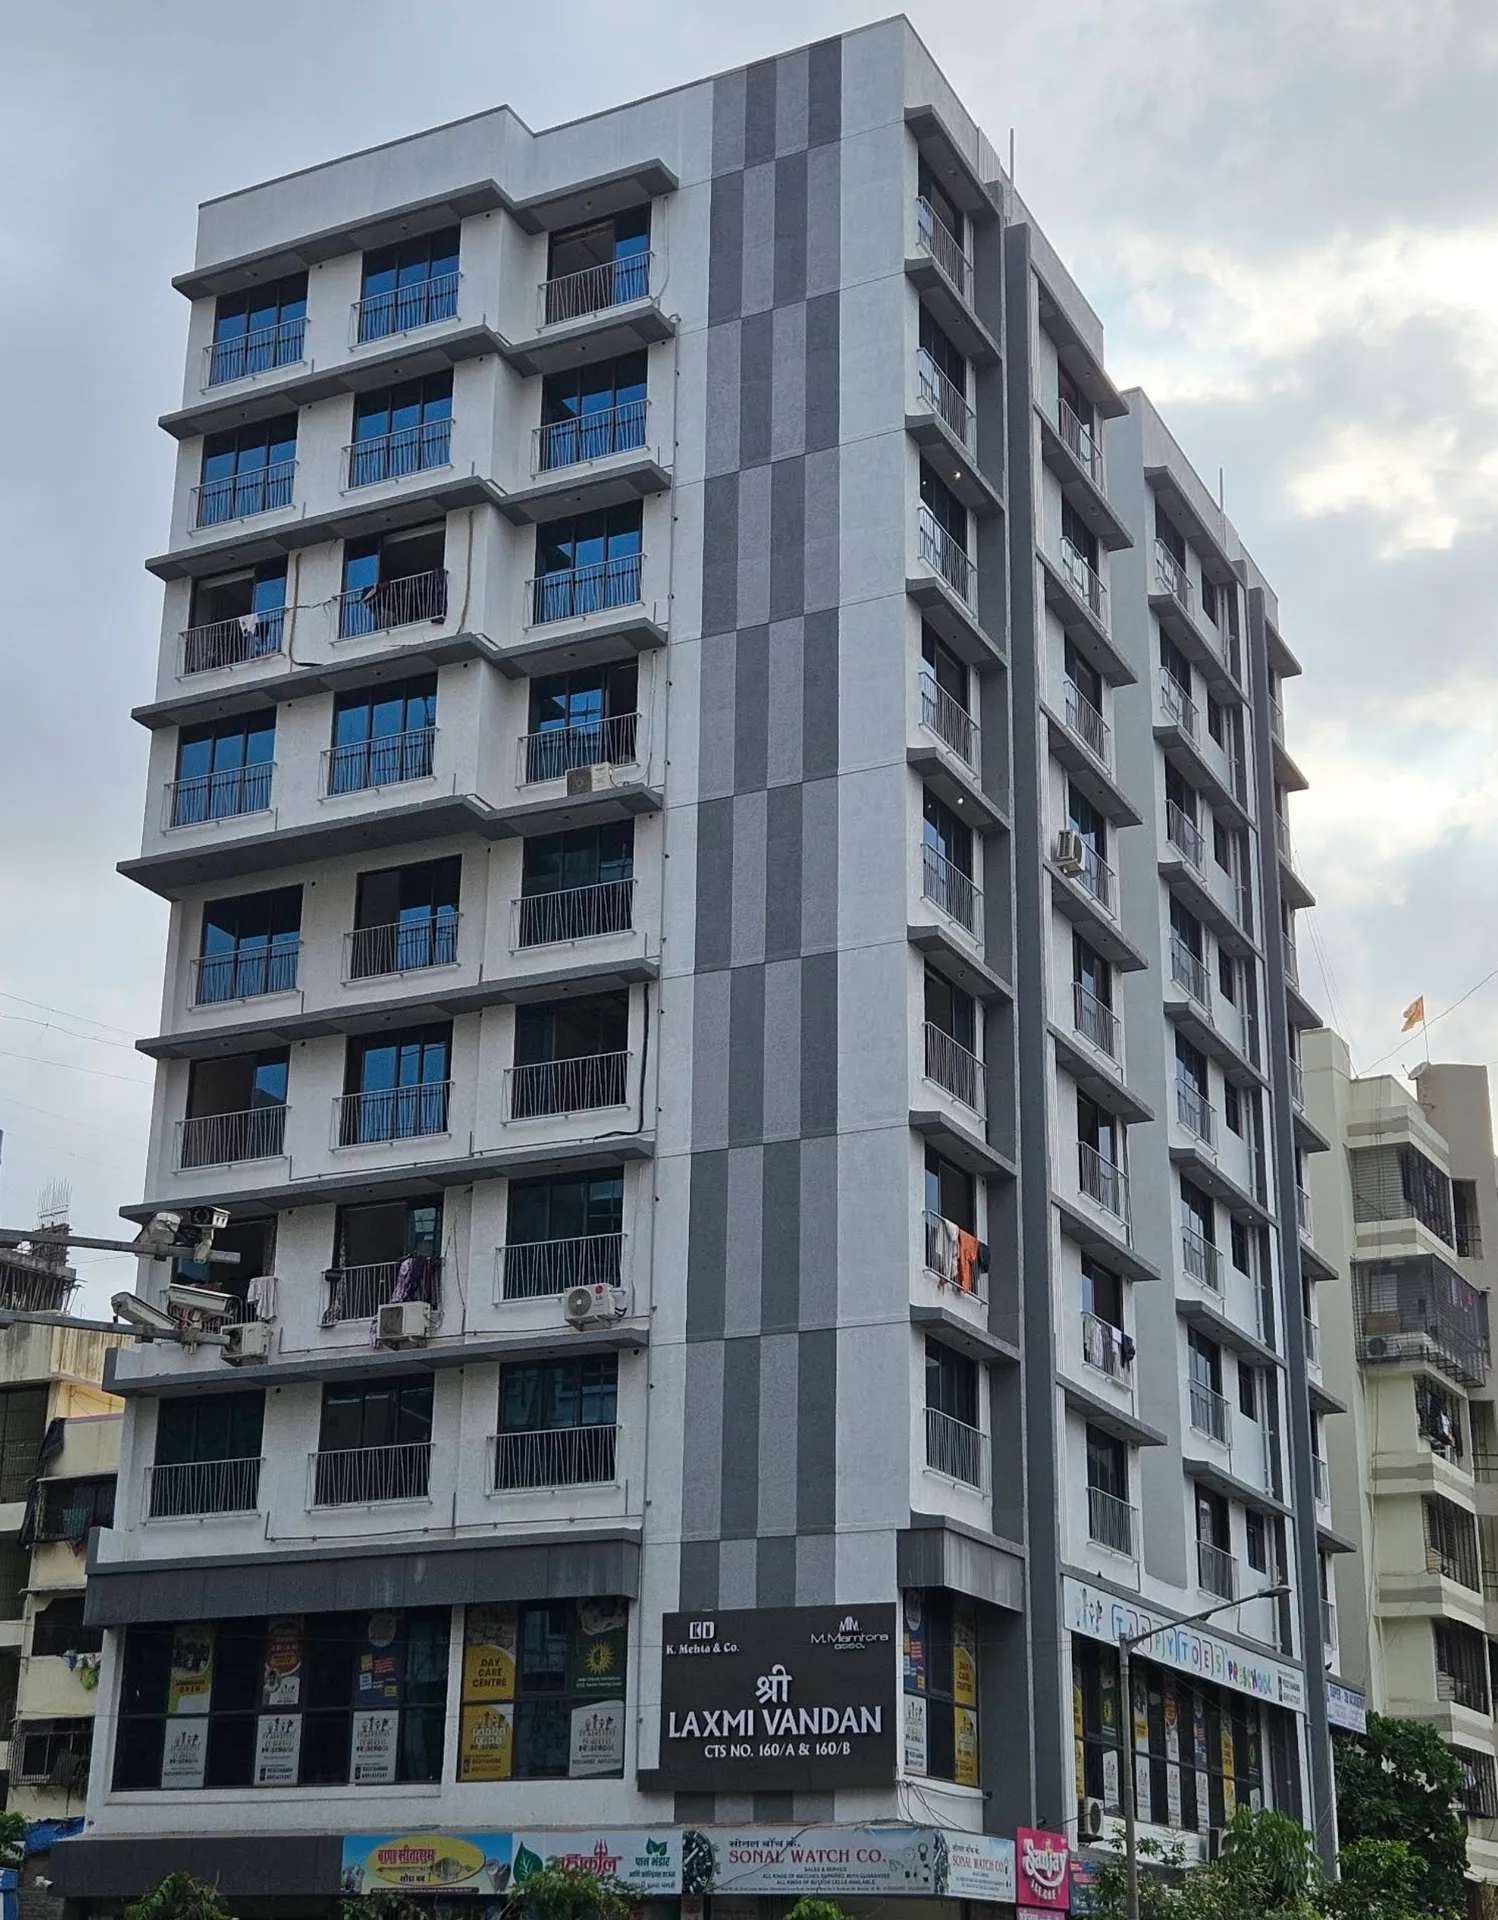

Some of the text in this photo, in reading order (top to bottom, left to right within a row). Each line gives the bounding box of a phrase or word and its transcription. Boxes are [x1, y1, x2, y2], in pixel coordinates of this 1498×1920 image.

[666, 1642, 740, 1655] K. Mehta & Co.
[480, 1658, 501, 1667] DAY
[1180, 1641, 1222, 1674] TOES
[478, 1667, 502, 1677] CARE
[472, 1677, 507, 1688] CENTRE
[755, 1663, 792, 1704] श्री
[669, 1705, 882, 1738] LAXMI VANDAN
[704, 1742, 851, 1758] CTS NO. 160/A & 160/B
[729, 1848, 886, 1864] SONAL WATCH CO.
[1022, 1838, 1068, 1887] Sanjay
